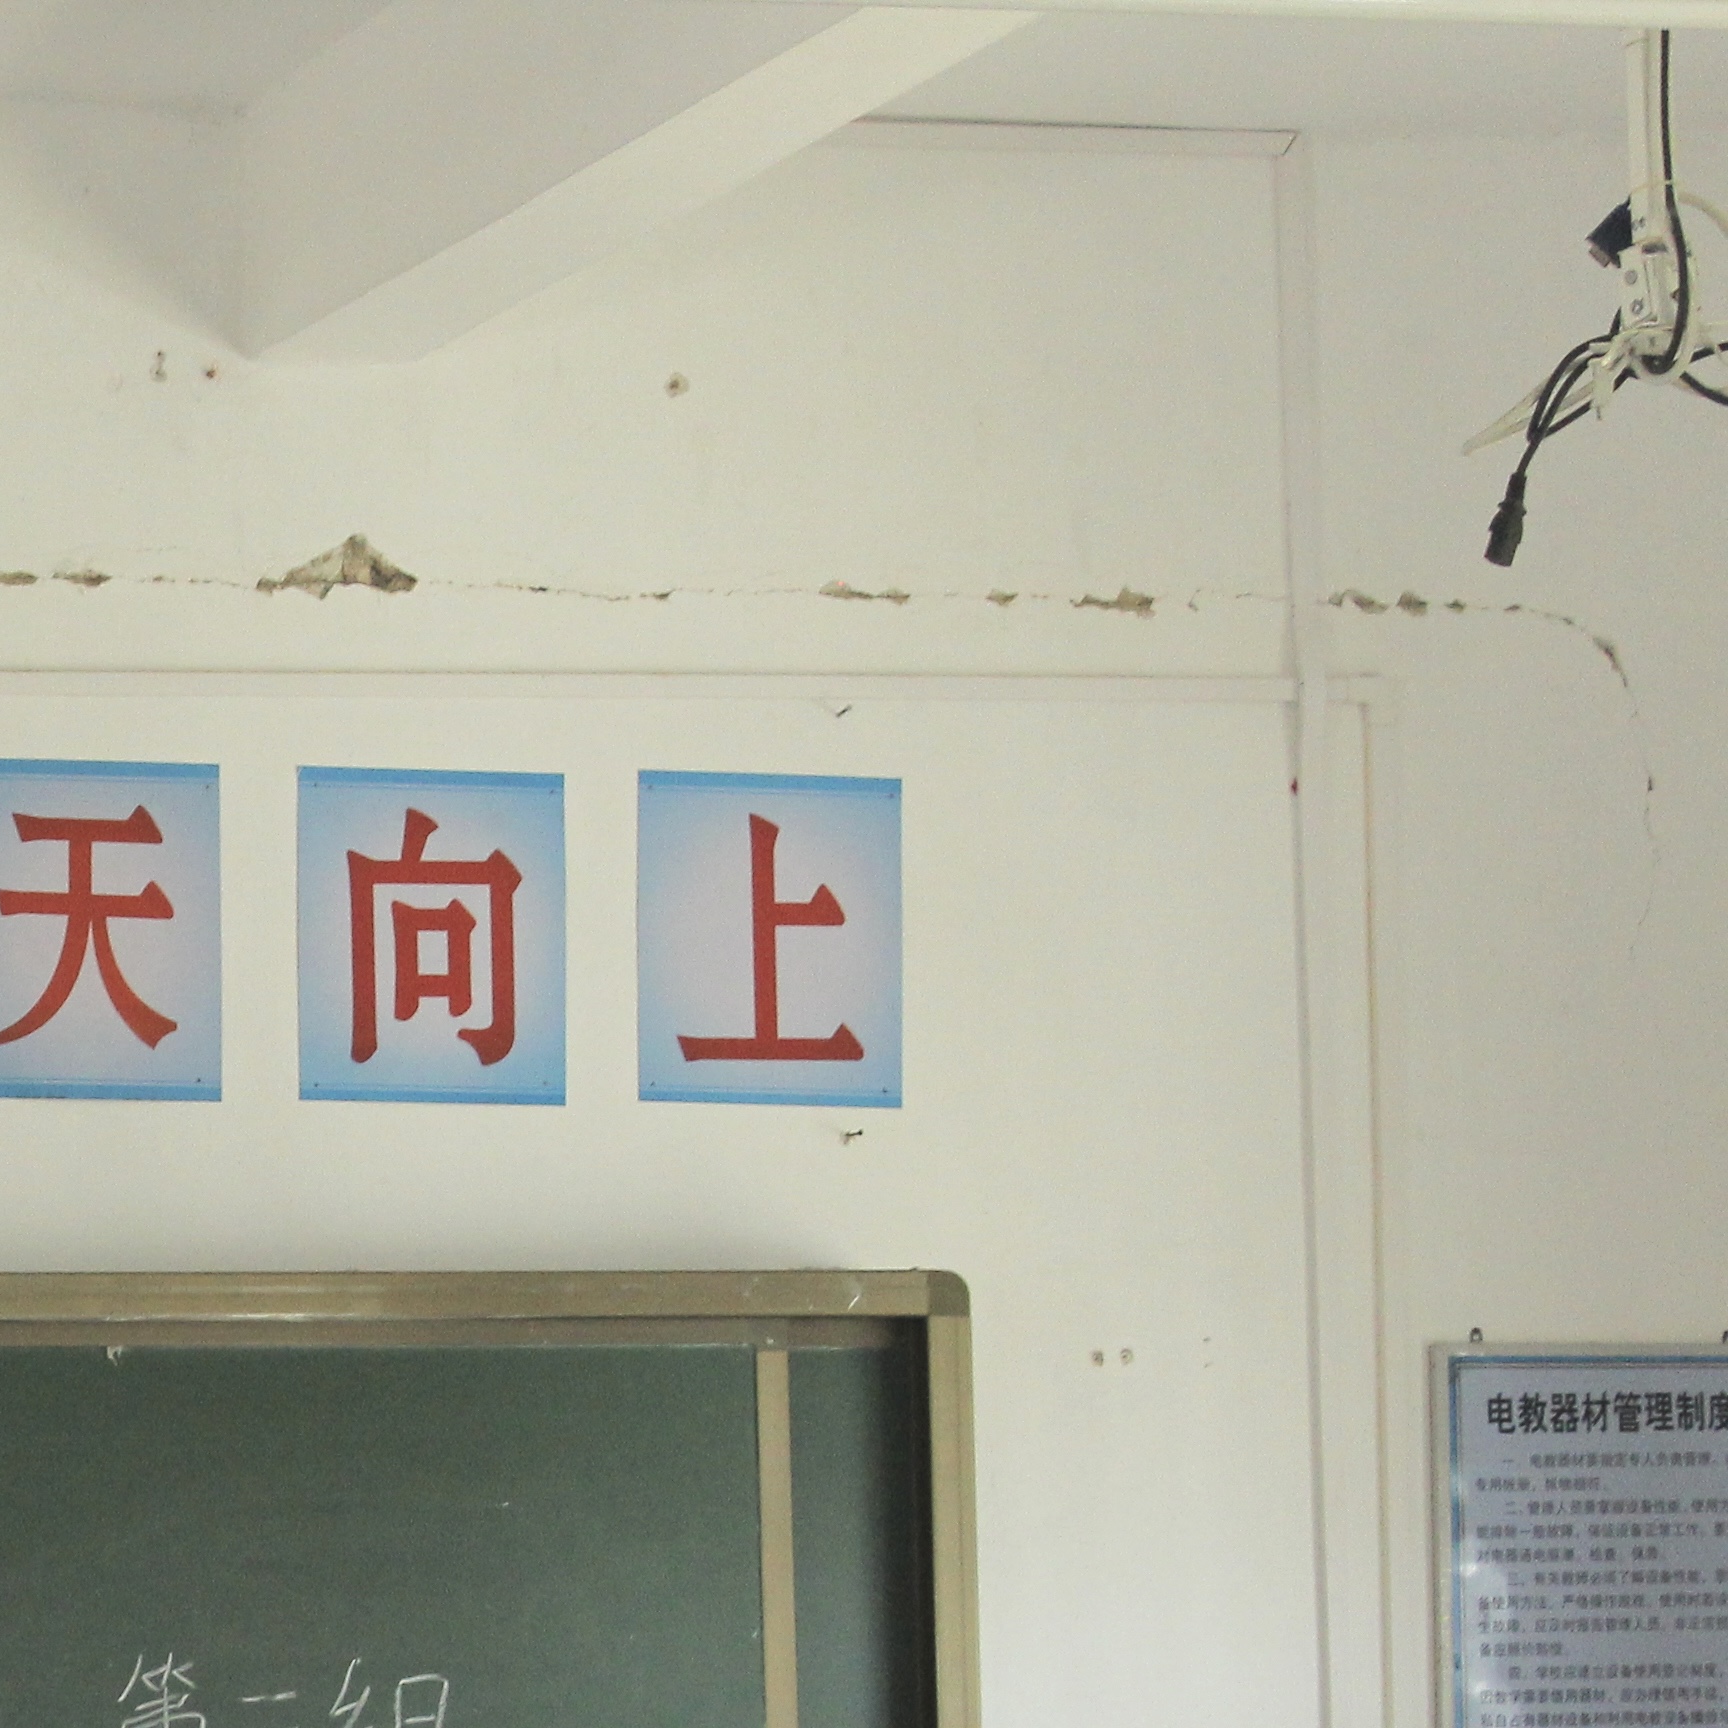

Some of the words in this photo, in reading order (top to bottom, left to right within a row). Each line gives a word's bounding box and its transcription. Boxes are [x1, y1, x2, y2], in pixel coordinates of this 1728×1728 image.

[1486, 1390, 1728, 1434] 电教器材管理制度
